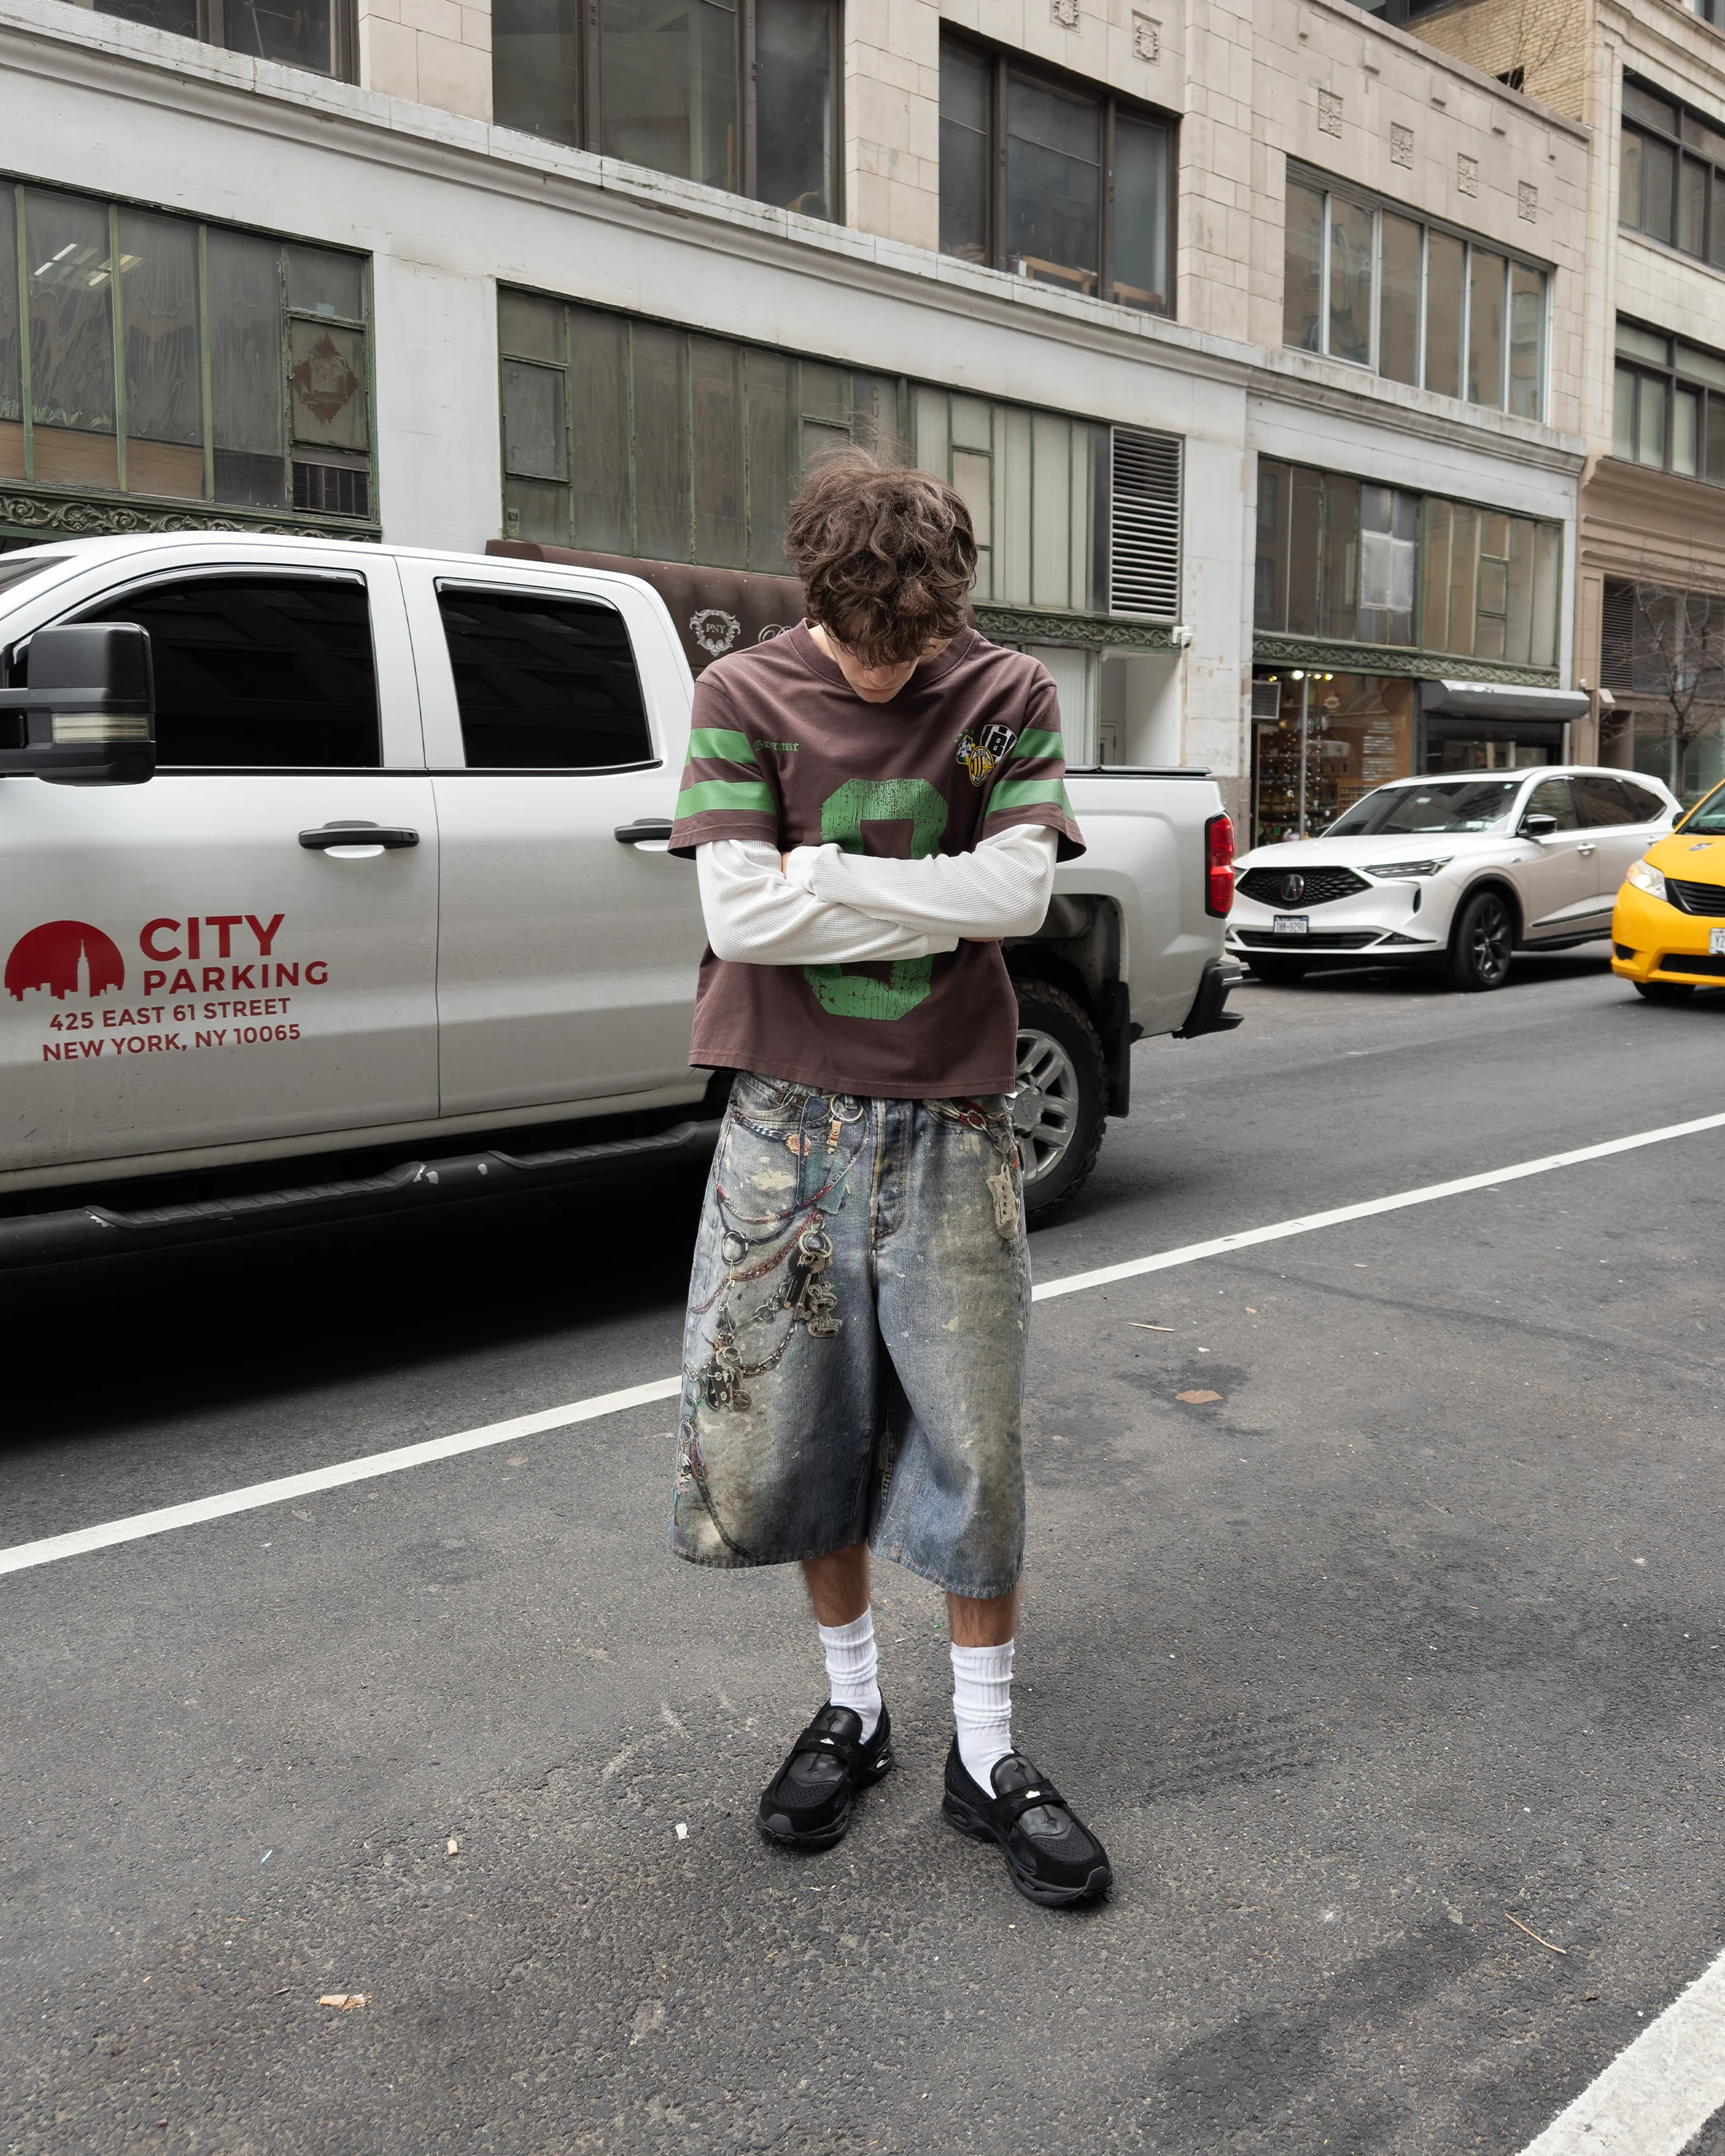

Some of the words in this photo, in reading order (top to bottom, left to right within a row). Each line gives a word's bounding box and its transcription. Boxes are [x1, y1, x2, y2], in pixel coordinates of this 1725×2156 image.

[705, 623, 727, 634] PNY
[139, 914, 285, 961] CITY
[144, 961, 328, 997] PARKING
[50, 1011, 94, 1031] 425
[102, 1006, 165, 1028] EAST
[173, 1004, 196, 1022] 61
[204, 997, 291, 1020] STREET
[42, 1039, 105, 1062] NEW
[110, 1032, 187, 1055] YORK,
[195, 1029, 227, 1048] NY
[233, 1024, 301, 1044] 10065
